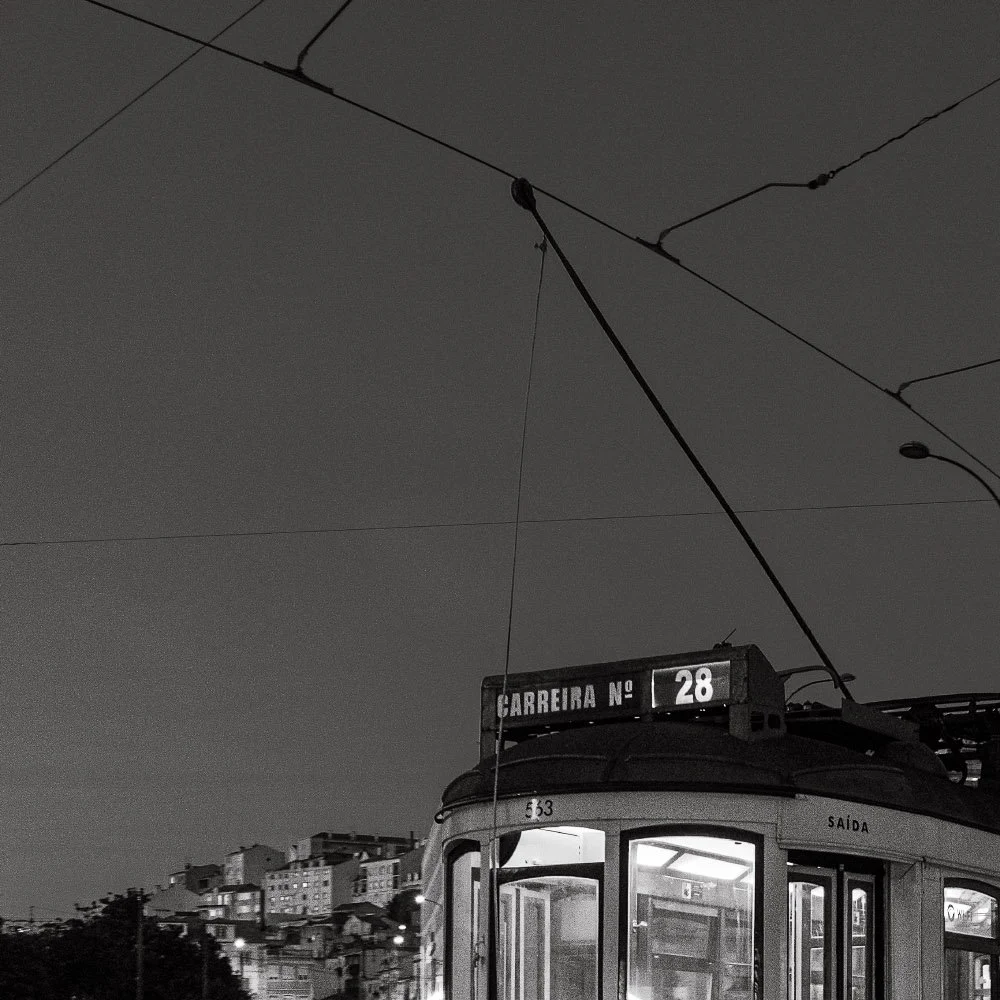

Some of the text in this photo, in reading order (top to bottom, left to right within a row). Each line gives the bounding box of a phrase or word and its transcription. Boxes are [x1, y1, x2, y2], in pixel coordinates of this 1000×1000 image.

[497, 684, 597, 718] CARREIRA
[675, 667, 714, 705] 28
[828, 815, 869, 834] SAÍDA
